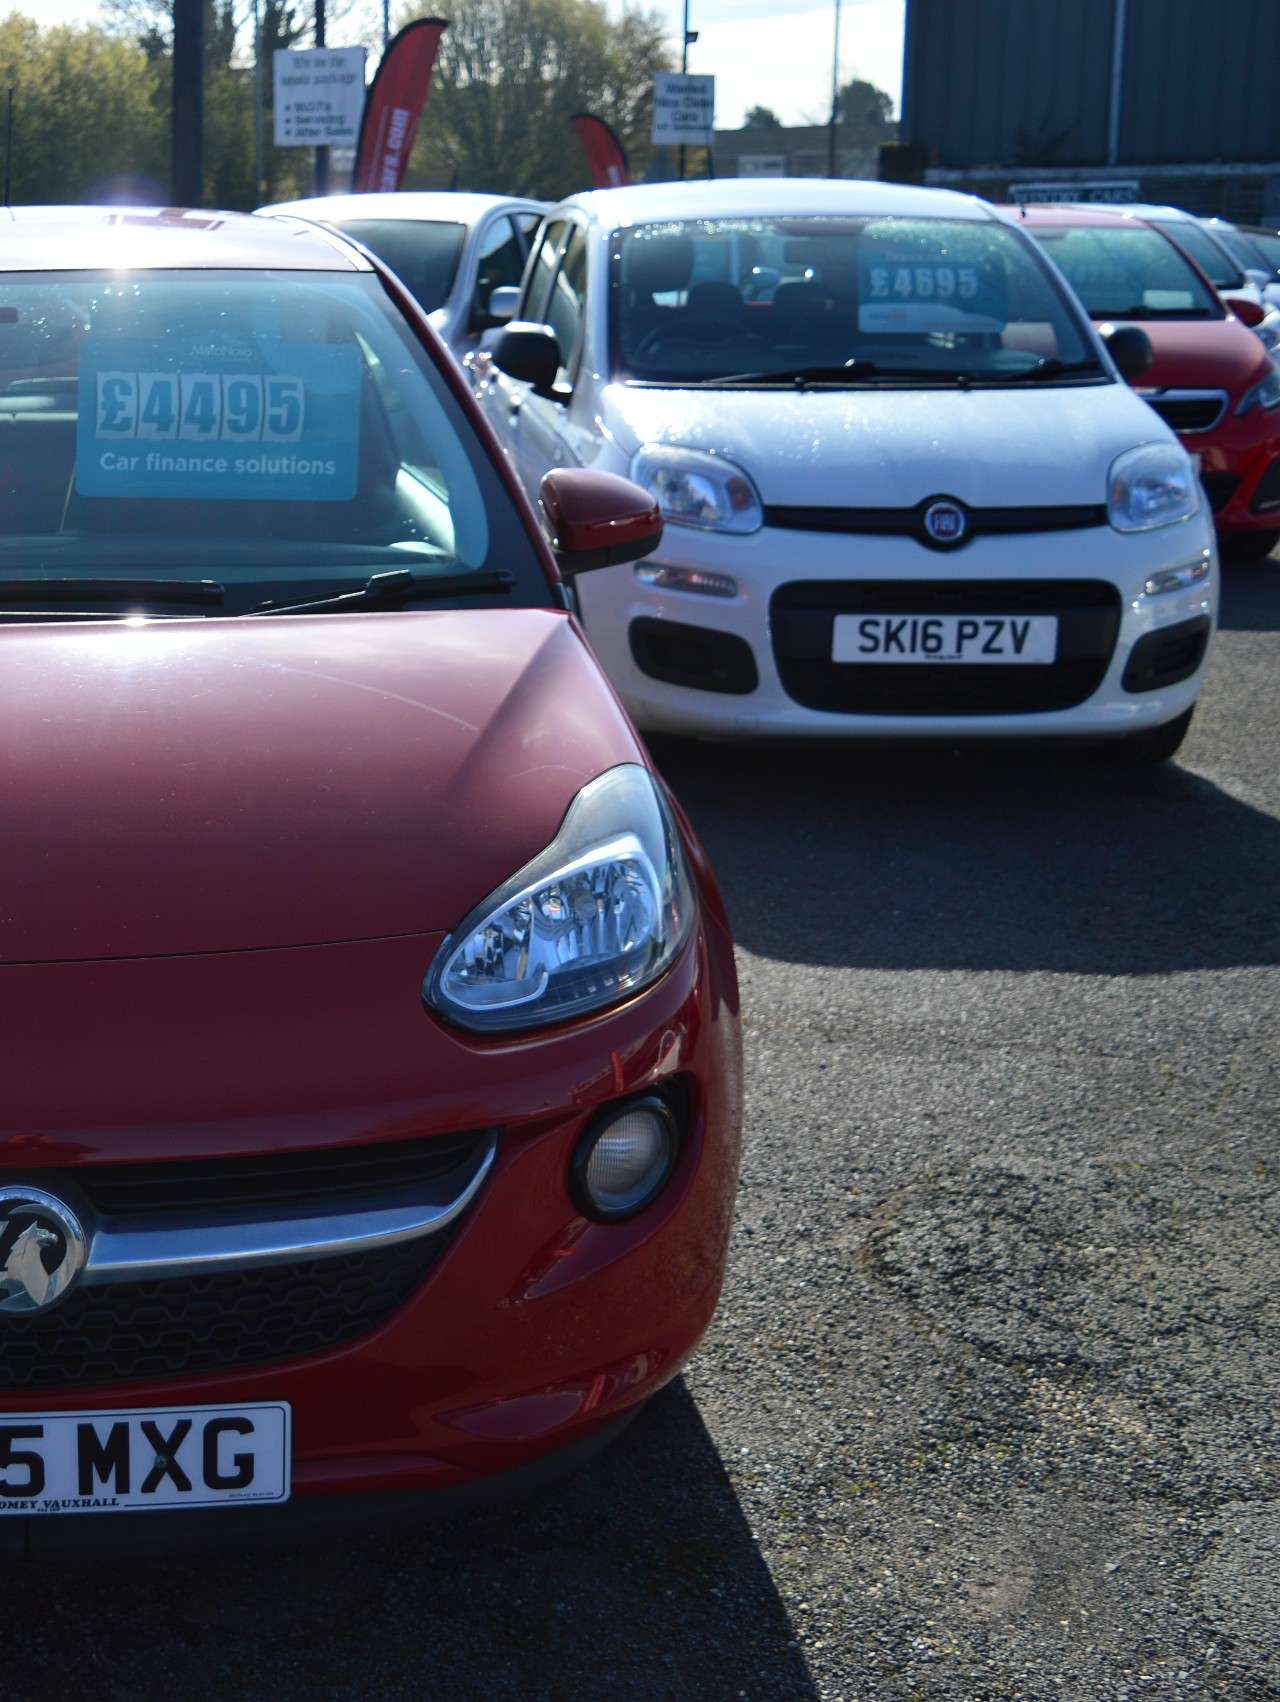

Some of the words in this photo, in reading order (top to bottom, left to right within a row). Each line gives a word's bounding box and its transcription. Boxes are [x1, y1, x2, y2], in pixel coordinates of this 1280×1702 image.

[870, 267, 978, 297] £4695
[99, 378, 302, 436] £4495
[99, 452, 139, 471] Car
[146, 452, 228, 473] finance
[234, 454, 336, 475] solutions
[858, 619, 943, 654] SK16
[955, 619, 1031, 654] PZV
[76, 1415, 256, 1496] MXG
[42, 1497, 120, 1509] VAUXHALL
